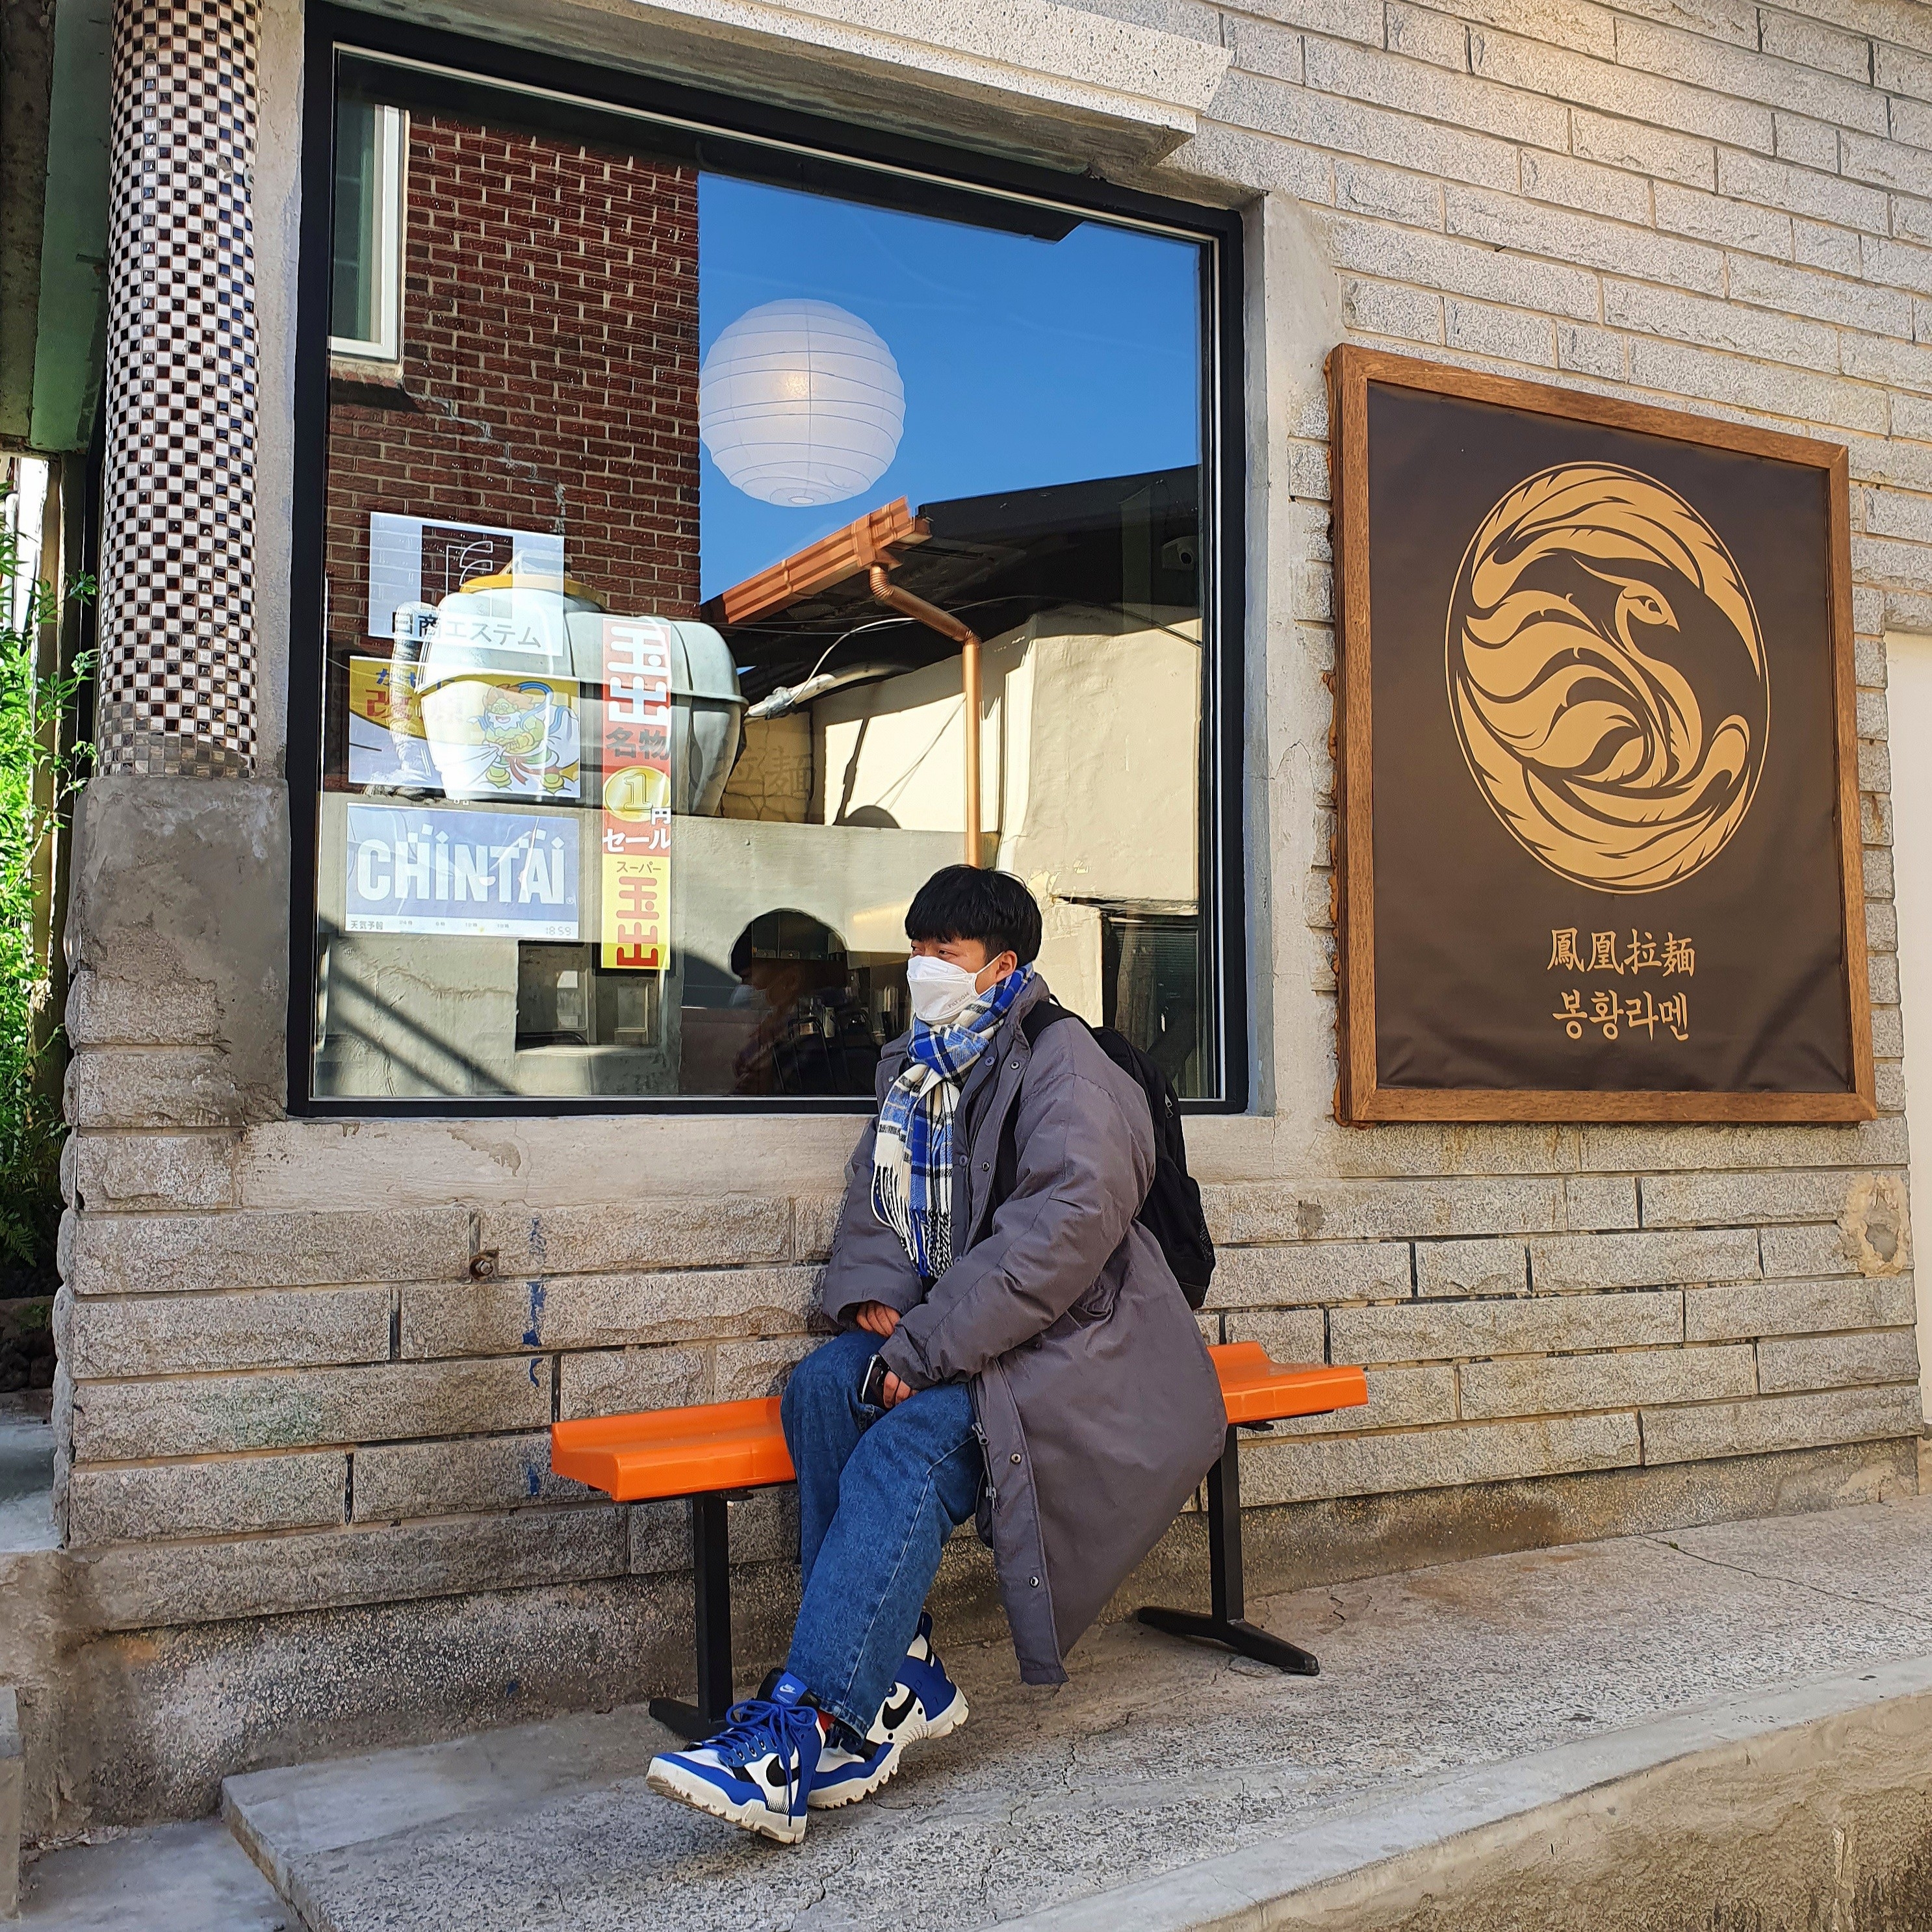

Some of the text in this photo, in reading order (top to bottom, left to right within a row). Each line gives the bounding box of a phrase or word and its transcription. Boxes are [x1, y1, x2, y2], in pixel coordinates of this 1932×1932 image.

[607, 626, 670, 726] 玉出
[606, 727, 670, 760] 名物
[603, 828, 671, 853] セール
[616, 860, 662, 873] スーパー
[616, 876, 660, 967] 玉出
[1552, 988, 1690, 1041] 봉황라멘
